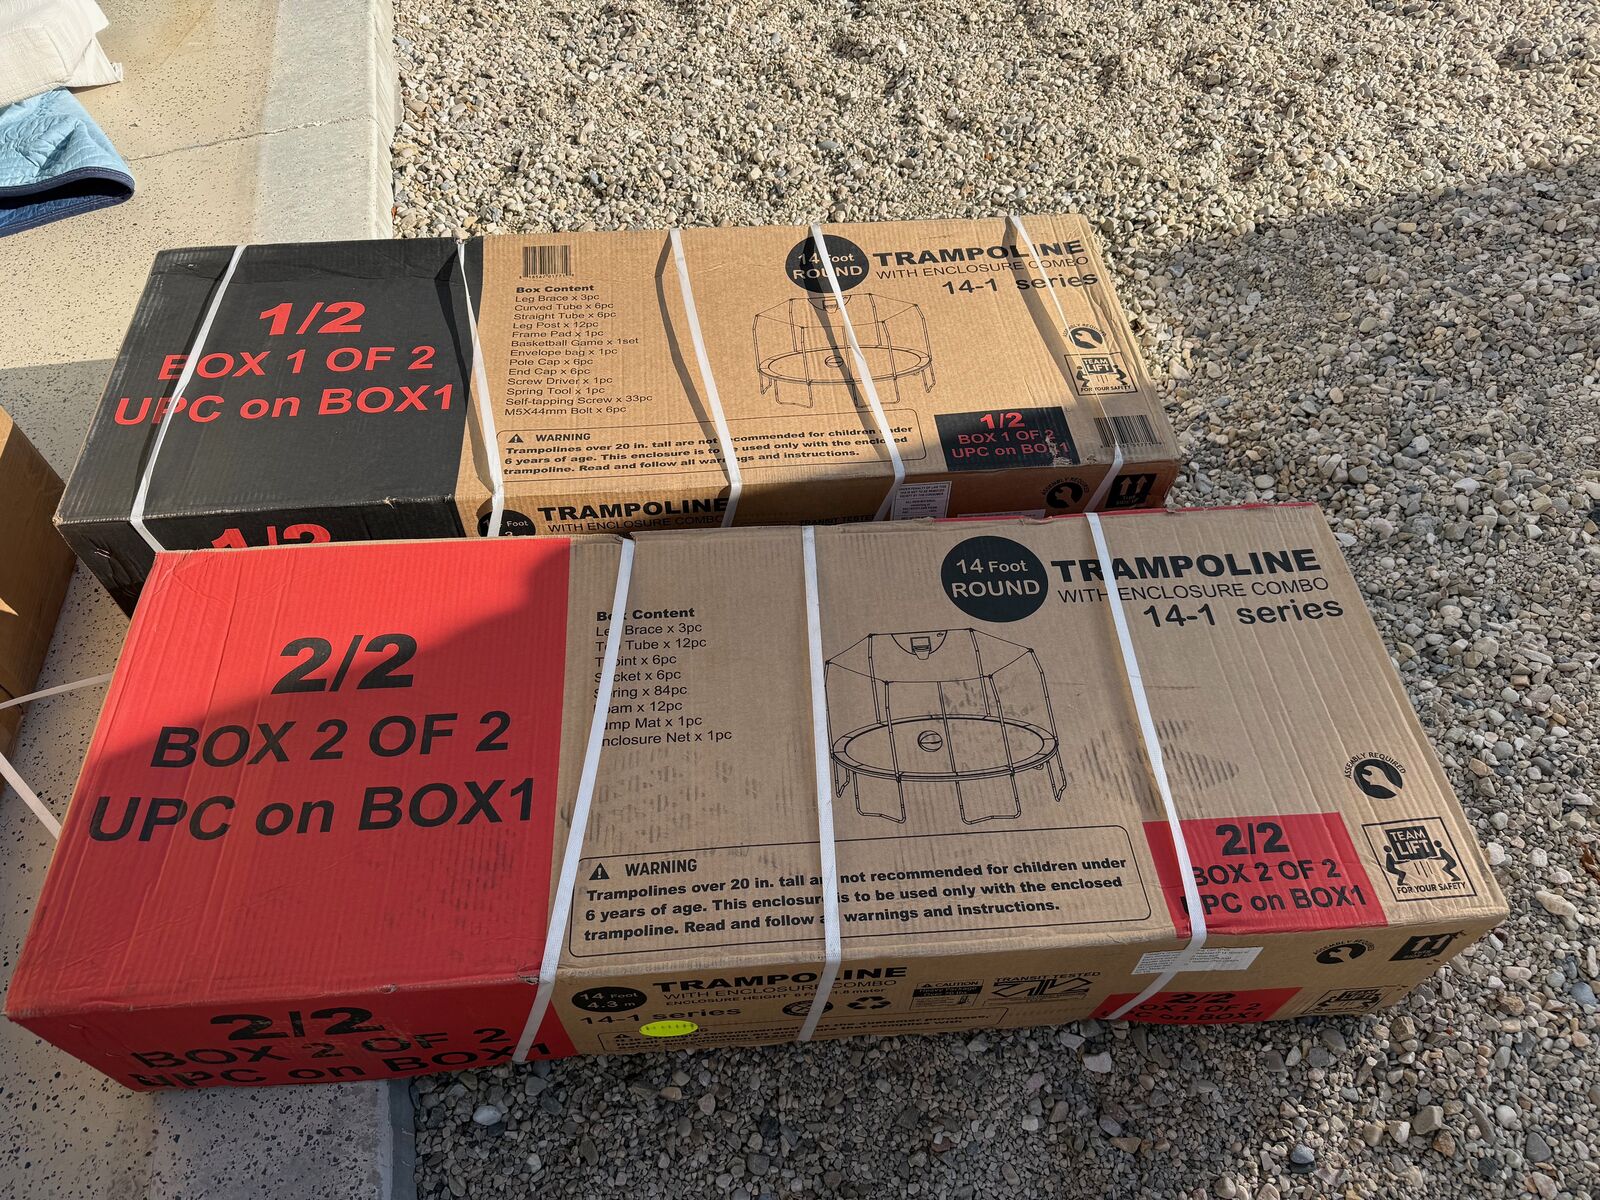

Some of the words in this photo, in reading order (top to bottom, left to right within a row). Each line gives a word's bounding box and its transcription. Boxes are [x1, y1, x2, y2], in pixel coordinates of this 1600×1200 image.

[798, 252, 820, 264] 14
[876, 264, 918, 280] WITH
[923, 260, 1025, 276] ENCLOSURE
[1028, 256, 1088, 269] COMBO
[942, 278, 998, 294] 14-1
[1016, 274, 1098, 290] series
[514, 304, 552, 312] Curved
[594, 302, 614, 310] 6pc
[580, 294, 600, 302] 3pc
[259, 302, 366, 336] 1/2
[286, 350, 306, 374] 1
[326, 347, 395, 372] OF
[408, 346, 436, 370] 2
[1086, 364, 1110, 372] LIFT
[114, 396, 224, 426] UPC
[239, 396, 298, 420] on
[318, 384, 454, 415] BOX1
[980, 412, 1025, 430] 1/2
[536, 433, 591, 444] WARNING
[958, 433, 996, 444] BOX
[1001, 432, 1008, 442] 1
[1012, 430, 1040, 441] OF
[1044, 430, 1056, 440] 2
[952, 446, 990, 458] UPC
[996, 447, 1018, 457] on
[538, 498, 729, 521] TRAMPOLINE
[548, 523, 584, 532] WITH
[587, 519, 669, 530] ENCLOSURE
[956, 558, 984, 574] 14
[988, 559, 1028, 573] Foot
[1051, 548, 1320, 582] TRAMPOLINE
[952, 579, 1040, 598] ROUND
[1058, 588, 1108, 604] WITH
[1118, 582, 1246, 600] ENCLOSURE
[1251, 577, 1329, 596] COMBO
[632, 608, 694, 620] Content
[1143, 604, 1216, 628] 14-1
[1236, 599, 1344, 626] series
[625, 625, 662, 635] Brace
[667, 625, 674, 633] x
[678, 623, 702, 635] 3pc
[625, 640, 658, 650] Tube
[676, 638, 706, 650] 12pc
[271, 634, 417, 694] 2/2
[594, 671, 640, 682] Scket
[645, 672, 652, 680] x
[656, 670, 682, 682] 6pc
[594, 688, 638, 699] Sring
[642, 688, 650, 696] x
[654, 686, 688, 698] 84pc
[636, 718, 660, 728] Mat
[666, 719, 672, 727] x
[679, 716, 702, 728] 1pc
[150, 720, 296, 768] BOX
[310, 719, 348, 760] 2
[368, 713, 458, 758] OF
[476, 710, 511, 752] 2
[602, 734, 662, 746] nclosure
[666, 732, 690, 743] Net
[694, 734, 702, 742] x
[706, 730, 732, 742] 1pc
[1344, 752, 1366, 780] ASSEMBLY
[1368, 752, 1406, 774] REQUIRED
[89, 796, 236, 842] UPC
[255, 800, 335, 836] on
[358, 778, 534, 830] BOX1
[1215, 822, 1290, 856] 2/2
[1390, 830, 1426, 841] TEAM
[1395, 840, 1431, 854] LIFT
[625, 858, 697, 878] WARNING
[1192, 864, 1252, 886] BOX
[1254, 862, 1273, 882] 2
[1278, 860, 1316, 880] OF
[1321, 858, 1341, 878] 2
[587, 885, 686, 902] Trampolines
[692, 882, 726, 892] over
[730, 878, 750, 890] 20
[754, 878, 774, 888] in.
[779, 876, 804, 887] tall
[840, 871, 866, 884] not
[870, 865, 983, 882] recommended
[987, 864, 1008, 875] for
[1013, 860, 1078, 874] children
[1082, 858, 1126, 870] under
[1396, 886, 1414, 894] FOR
[1415, 884, 1436, 893] YOUR
[1438, 882, 1466, 890] SAFETY
[586, 910, 596, 921] 6
[600, 906, 645, 922] years
[651, 904, 667, 916] of
[672, 903, 707, 917] age.
[712, 898, 747, 912] This
[752, 895, 823, 908] enclosur
[838, 892, 850, 903] is
[854, 891, 870, 902] to
[875, 889, 895, 902] be
[900, 886, 938, 900] used
[943, 884, 976, 898] only
[980, 882, 1016, 895] with
[1020, 880, 1046, 893] the
[1050, 876, 1122, 891] enclosed
[1250, 892, 1286, 912] on
[1289, 885, 1368, 909] BOX1
[584, 925, 679, 941] trampoline.
[684, 919, 726, 933] Read
[730, 916, 760, 930] and
[765, 914, 814, 927] follow
[844, 908, 918, 922] warnings
[923, 904, 953, 918] and
[958, 900, 1060, 916] instructions.
[580, 992, 604, 1000] 14
[664, 991, 714, 1000] WITH
[832, 980, 896, 988] COMBO
[586, 1001, 618, 1009] 4.3
[210, 1006, 384, 1041] 2/2
[580, 1014, 640, 1024] 14-1
[652, 1008, 742, 1020] series
[130, 1045, 287, 1068] BOX
[302, 1042, 344, 1059] 2
[362, 1032, 448, 1054] OF
[473, 1028, 510, 1044] 2
[288, 1060, 366, 1079] on
[382, 1042, 552, 1072] BOX1
